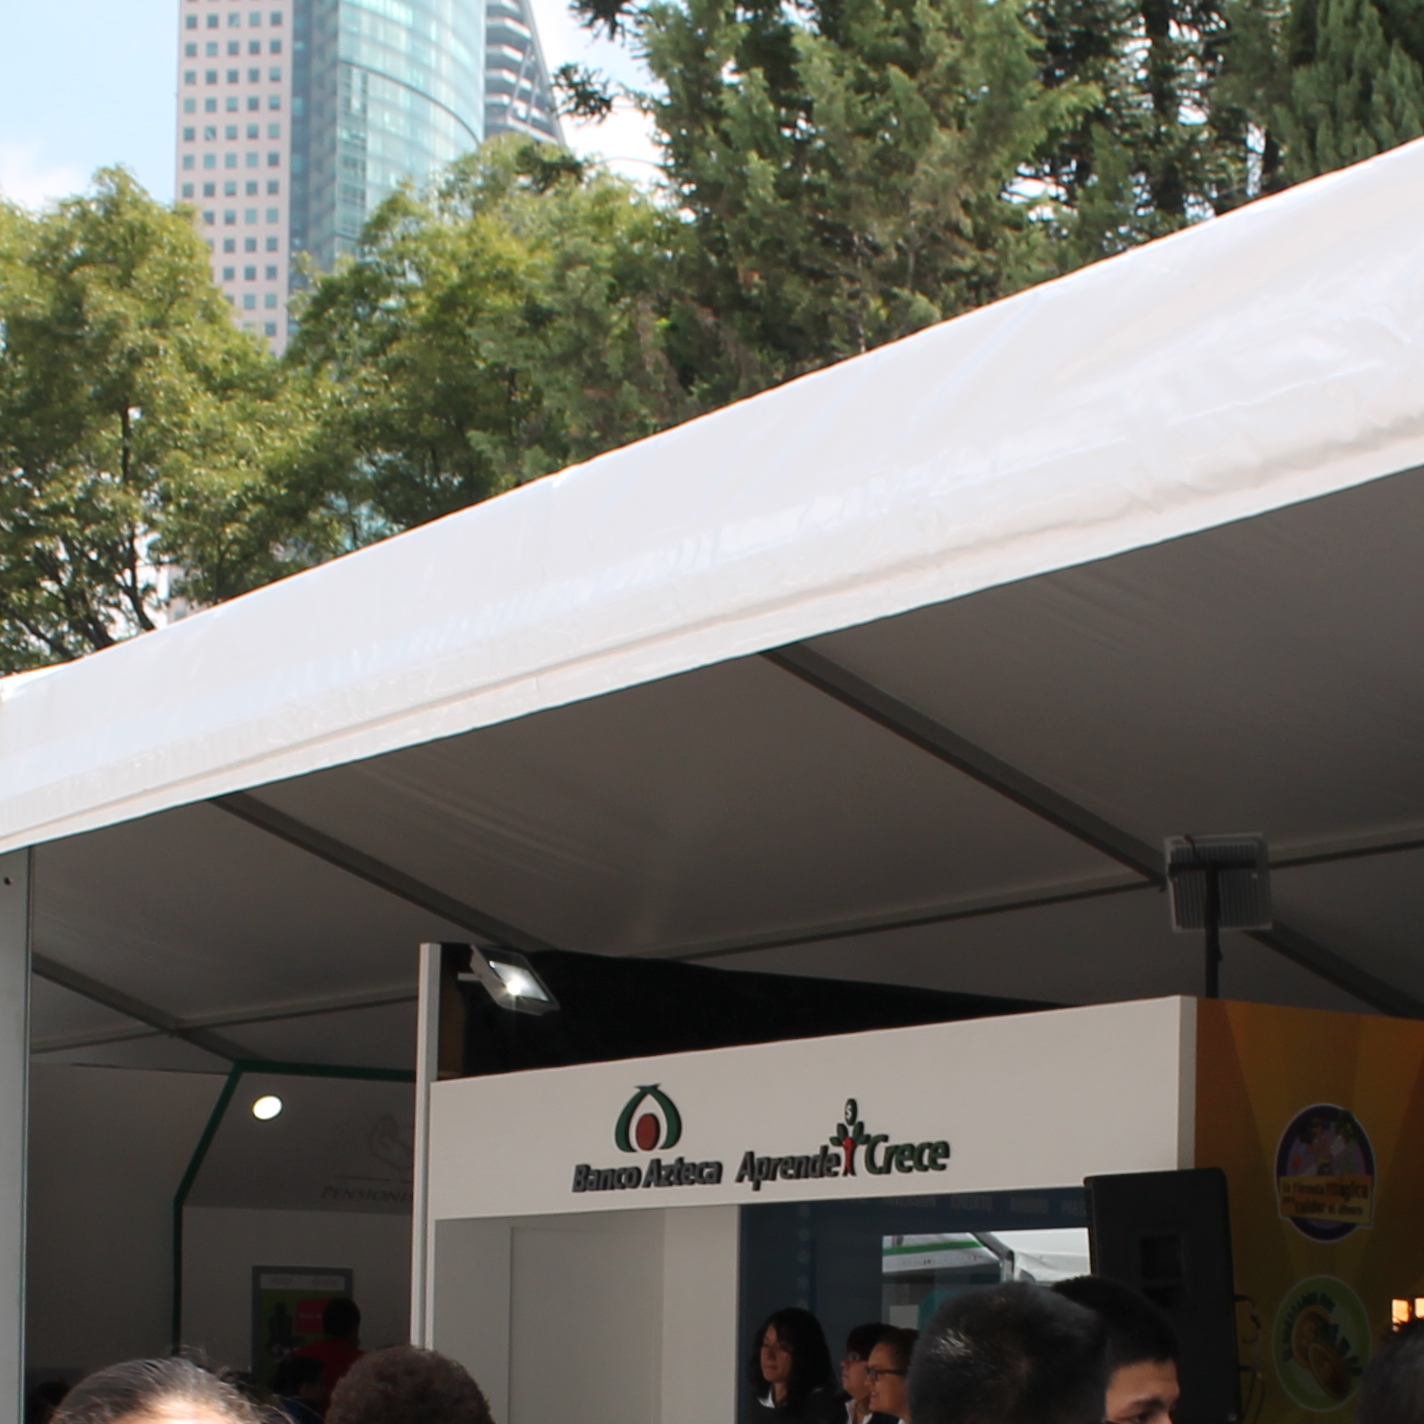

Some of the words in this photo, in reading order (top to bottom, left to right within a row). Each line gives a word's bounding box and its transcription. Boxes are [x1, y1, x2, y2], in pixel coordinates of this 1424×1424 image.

[572, 1163, 642, 1193] Banco
[641, 1156, 724, 1189] Azteca
[734, 1145, 842, 1192] Aprende
[864, 1133, 951, 1175] Crece
